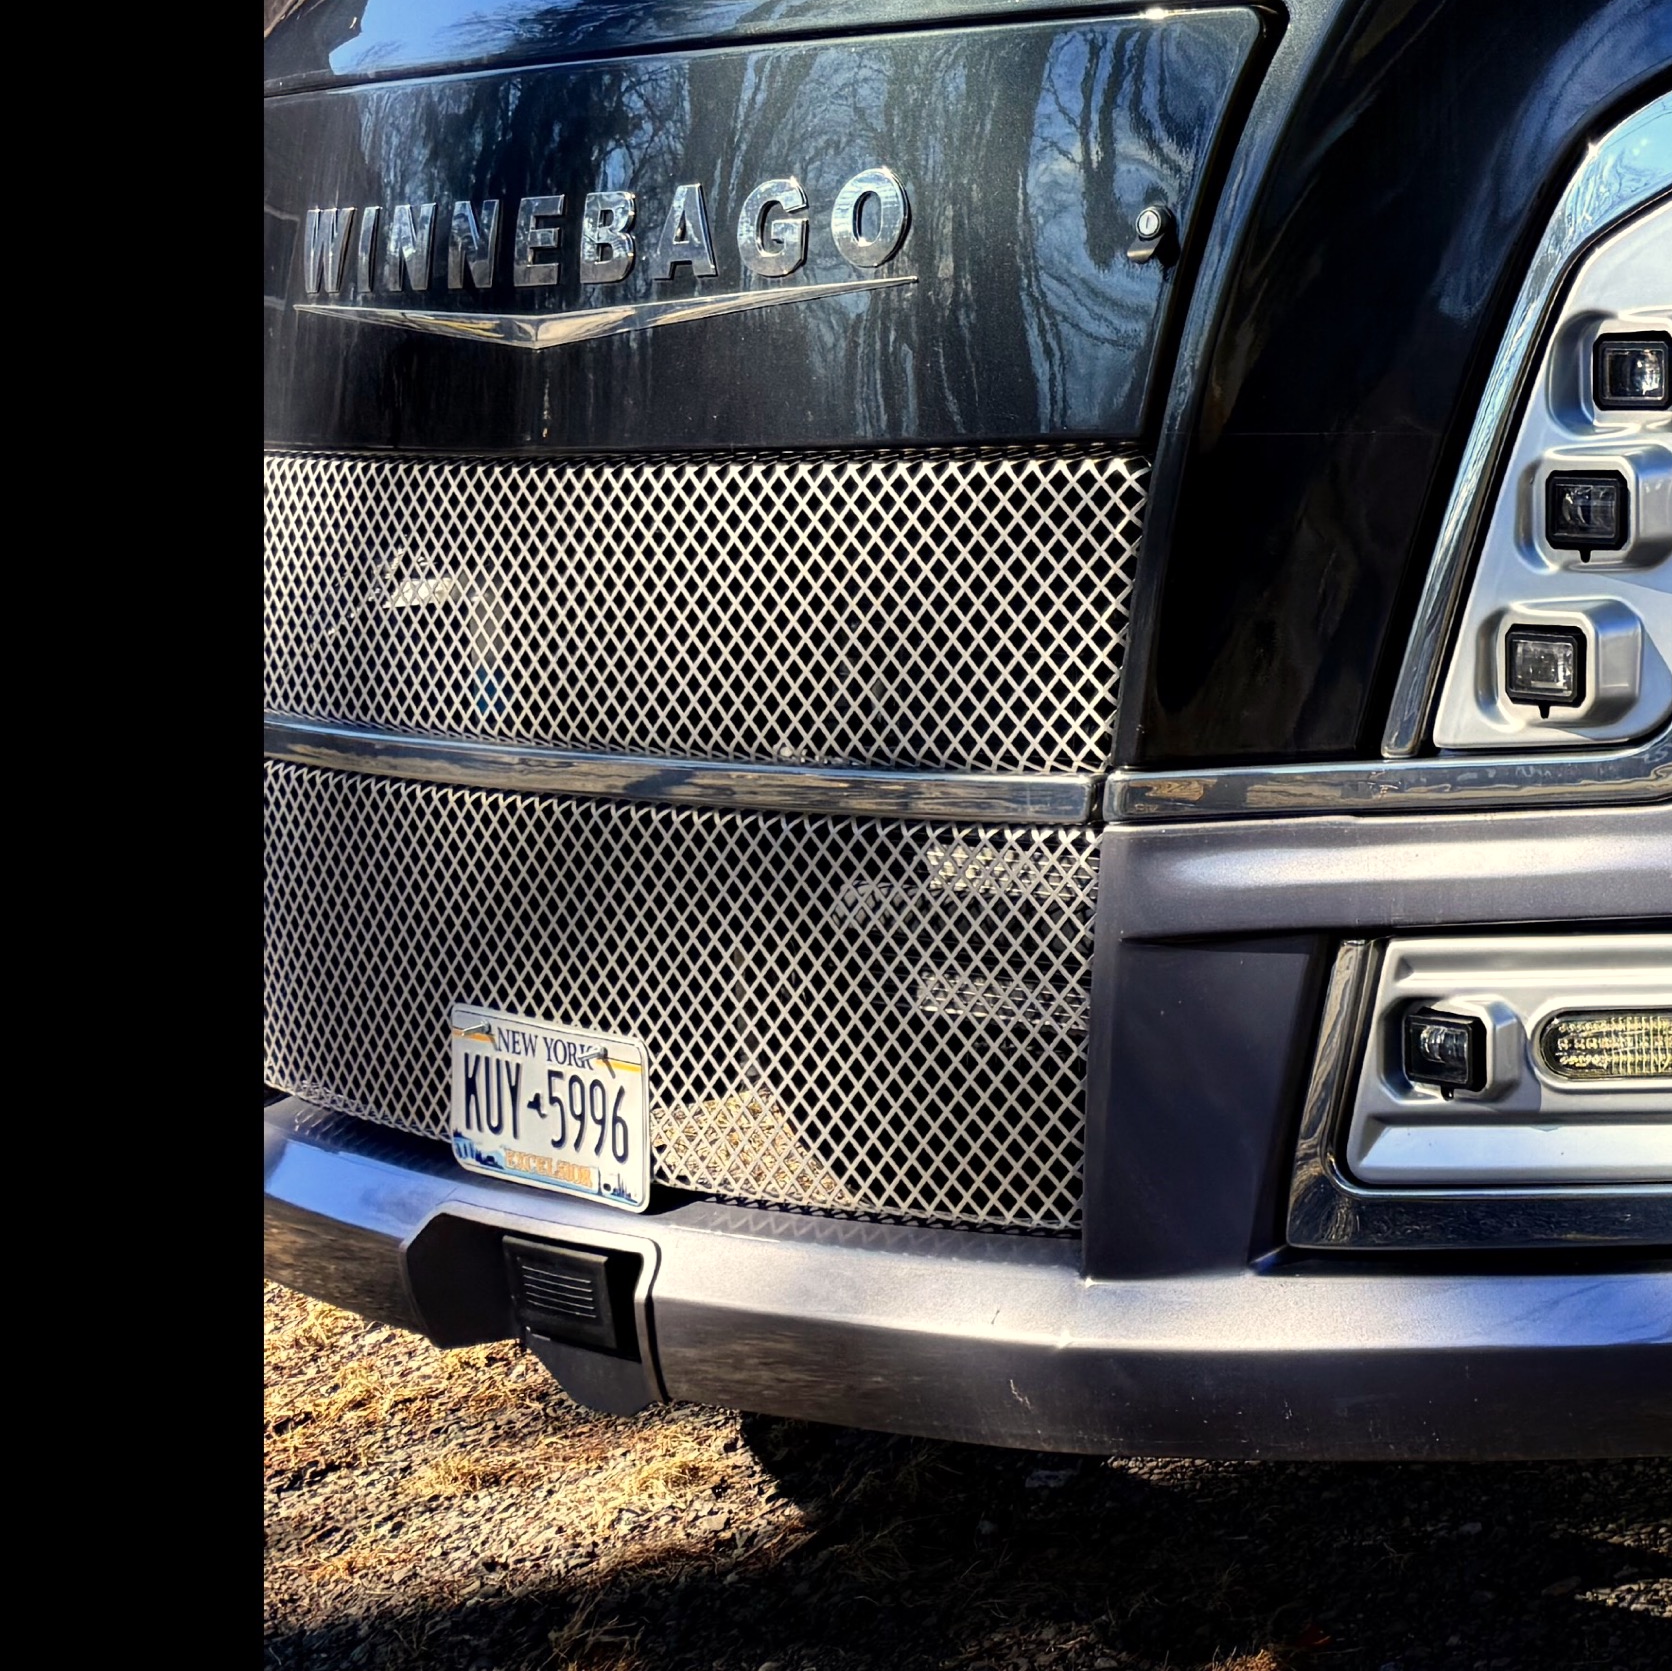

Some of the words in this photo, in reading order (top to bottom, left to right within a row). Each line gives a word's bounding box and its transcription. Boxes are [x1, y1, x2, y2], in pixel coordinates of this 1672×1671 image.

[304, 165, 913, 295] WINNEBAGO
[496, 1027, 539, 1058] NEW
[542, 1036, 595, 1071] YORK
